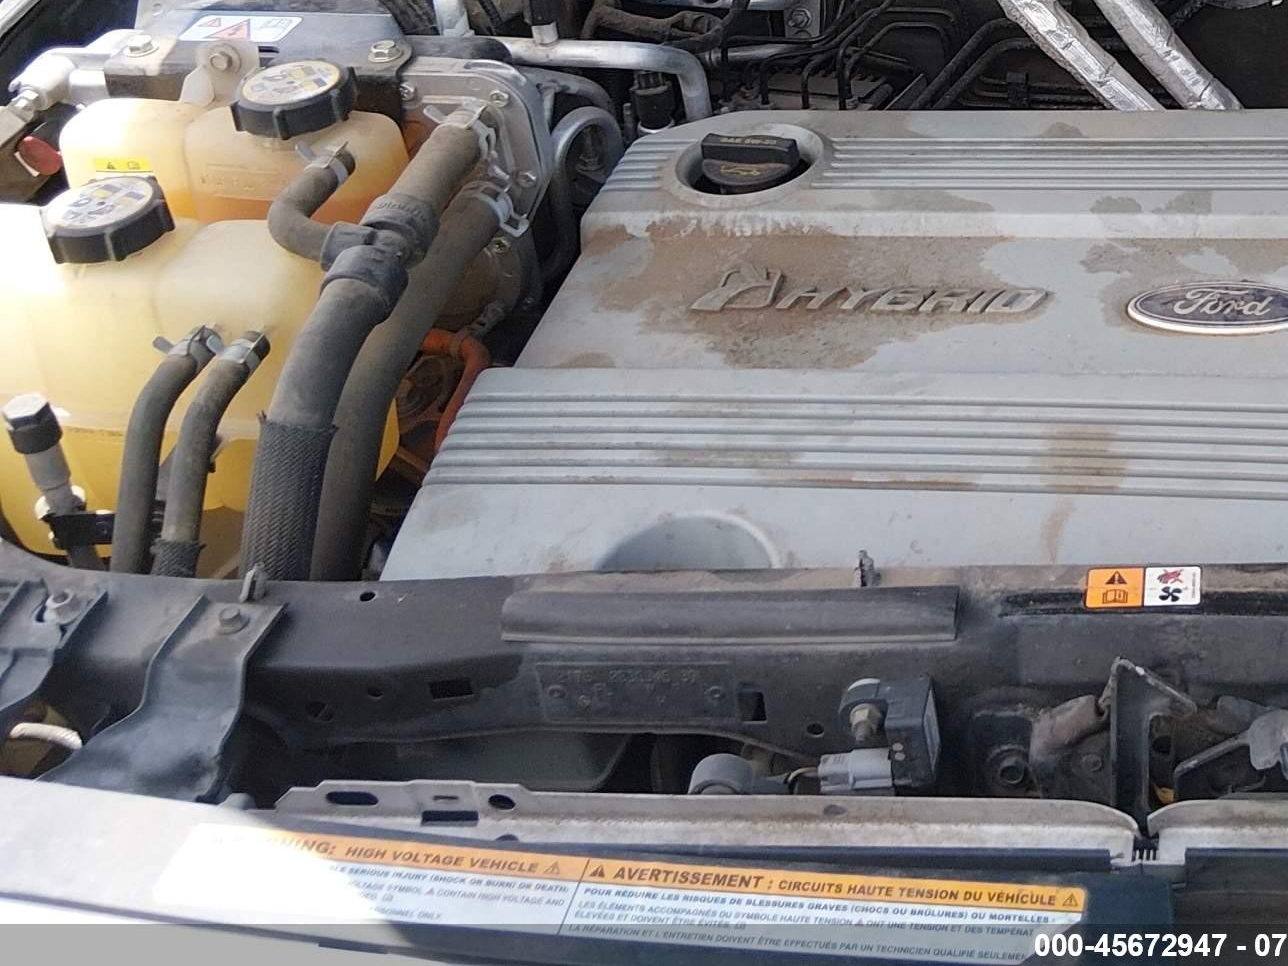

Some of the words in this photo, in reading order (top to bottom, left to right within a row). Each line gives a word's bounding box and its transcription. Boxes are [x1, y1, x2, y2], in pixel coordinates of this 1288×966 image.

[776, 286, 1049, 315] HYBRID
[1173, 288, 1274, 316] Ford
[345, 846, 387, 860] HIGH
[392, 850, 464, 867] VOLTAGE
[470, 857, 540, 873] VEHICLE
[614, 866, 764, 889] AVERTISSEMENT
[778, 880, 843, 894] CIRCUITS
[846, 884, 894, 897] HAUTE
[899, 887, 960, 901] TENSION
[963, 890, 983, 902] DU
[987, 890, 1056, 906] VÉHICULE
[584, 888, 612, 897] POUR
[660, 892, 680, 902] LES
[682, 894, 726, 904] RISQUES
[728, 898, 743, 906] DE
[807, 902, 848, 912] GRAVES
[850, 904, 890, 915] (CHOCS
[892, 908, 907, 916] OU
[970, 912, 986, 920] OU
[780, 915, 812, 924] HAUTE
[814, 916, 855, 926] TENSION
[909, 923, 948, 932] TENSION
[950, 925, 962, 933] ET
[965, 926, 984, 934] DES
[839, 943, 858, 952] PAR
[860, 944, 874, 952] UN
[876, 946, 931, 956] TECHNICIEN
[978, 951, 1027, 962] SEULEMEN
